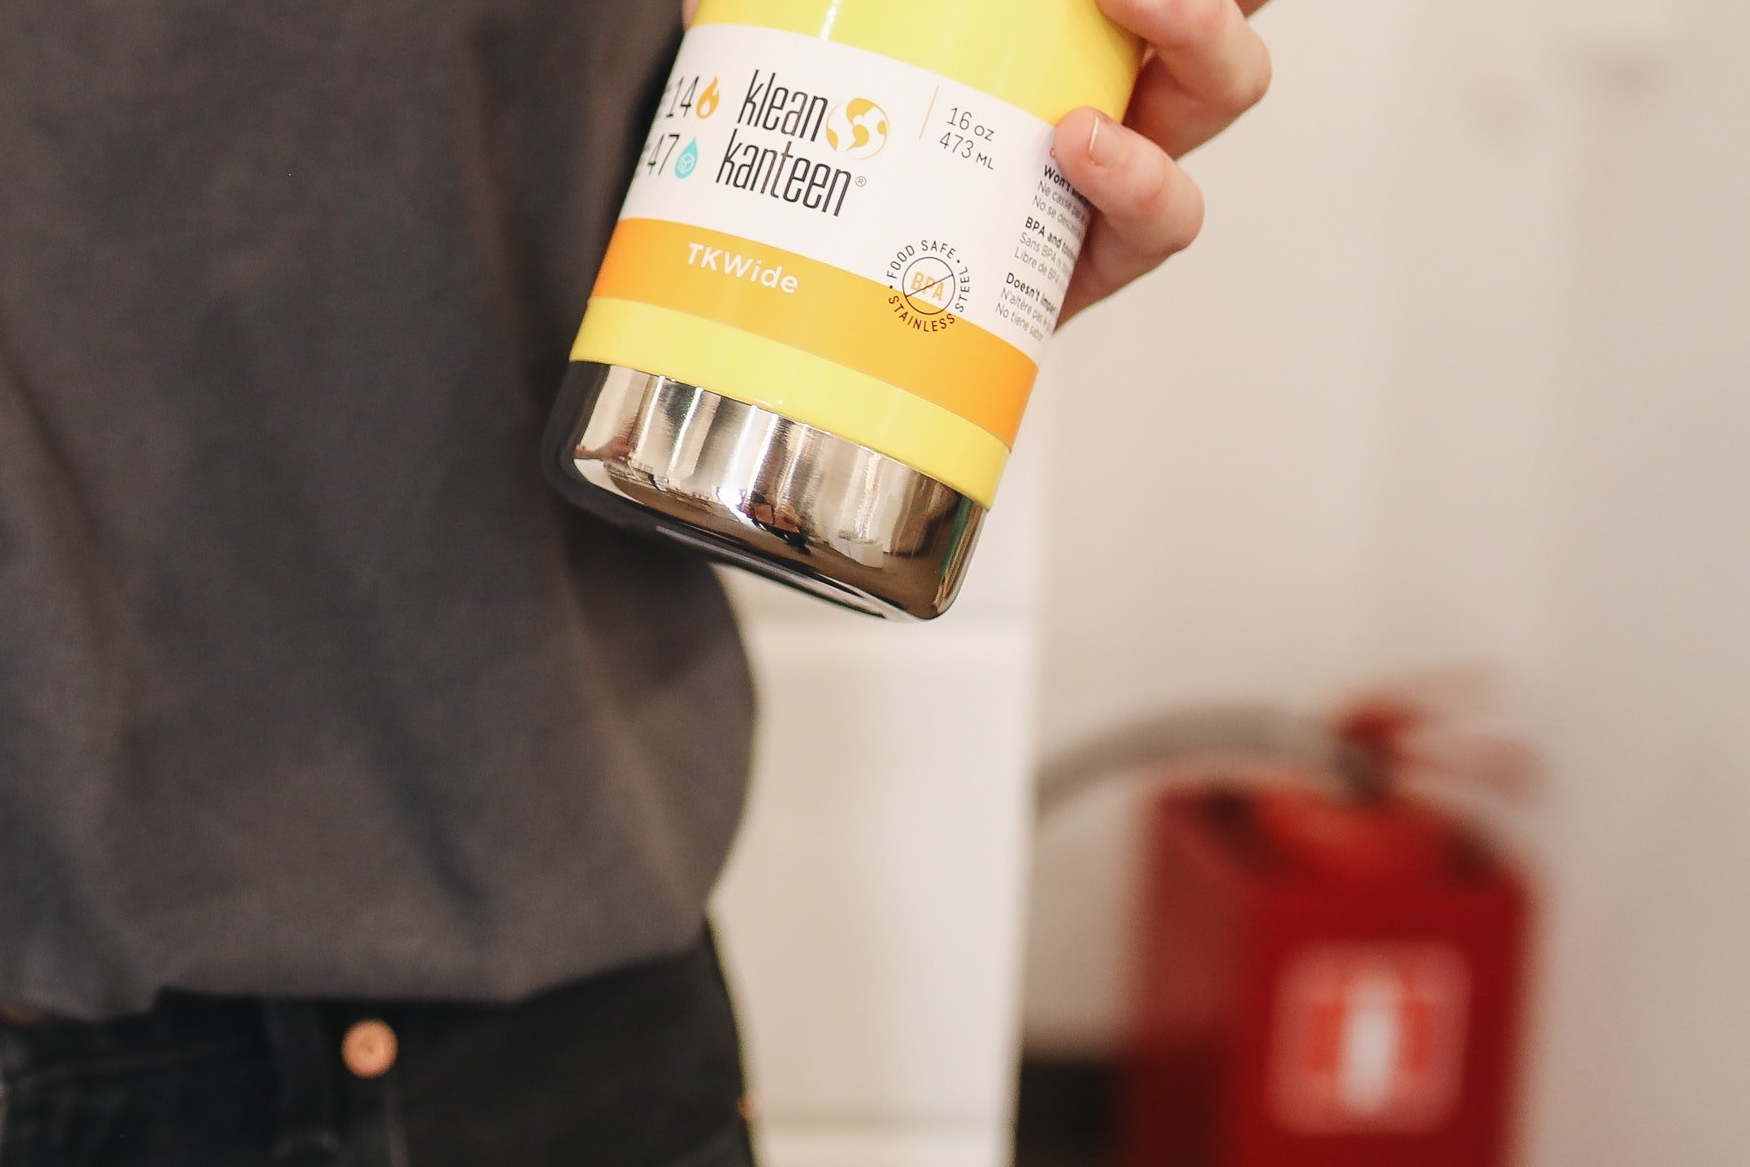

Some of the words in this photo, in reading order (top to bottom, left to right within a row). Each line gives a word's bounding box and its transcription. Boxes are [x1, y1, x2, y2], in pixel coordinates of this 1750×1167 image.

[737, 69, 828, 142] klean
[947, 107, 972, 130] 16
[974, 125, 995, 142] oz
[939, 132, 974, 158] 473
[975, 152, 994, 170] ML
[715, 128, 851, 217] kanteen
[1037, 180, 1051, 197] Ne
[1032, 195, 1046, 211] No
[1019, 231, 1040, 253] Sans
[1025, 216, 1045, 238] BPA
[1047, 232, 1062, 249] and
[688, 242, 799, 293] TKWide
[886, 245, 915, 279] FOOD
[921, 240, 957, 259] SAFE
[1014, 246, 1037, 268] Libre
[888, 295, 955, 332] STAINLESS
[955, 266, 970, 313] STEEL
[911, 271, 944, 301] BPA
[1006, 272, 1040, 302] Doesn't
[995, 302, 1009, 319] No
